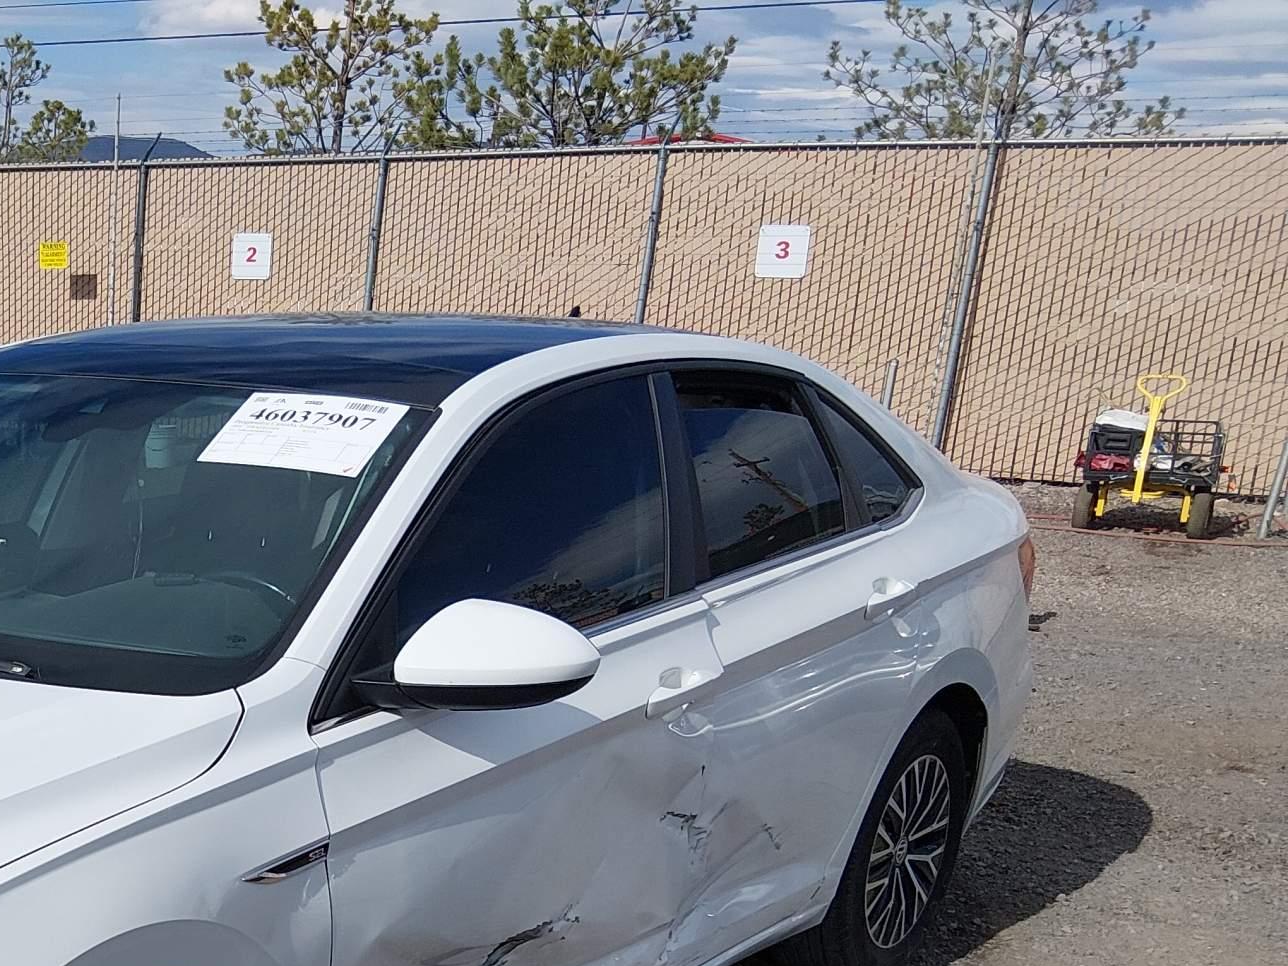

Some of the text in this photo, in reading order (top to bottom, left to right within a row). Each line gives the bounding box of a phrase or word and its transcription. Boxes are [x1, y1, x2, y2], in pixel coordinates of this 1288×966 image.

[246, 246, 257, 263] 2
[775, 240, 790, 260] 3
[249, 407, 377, 431] 46037907
